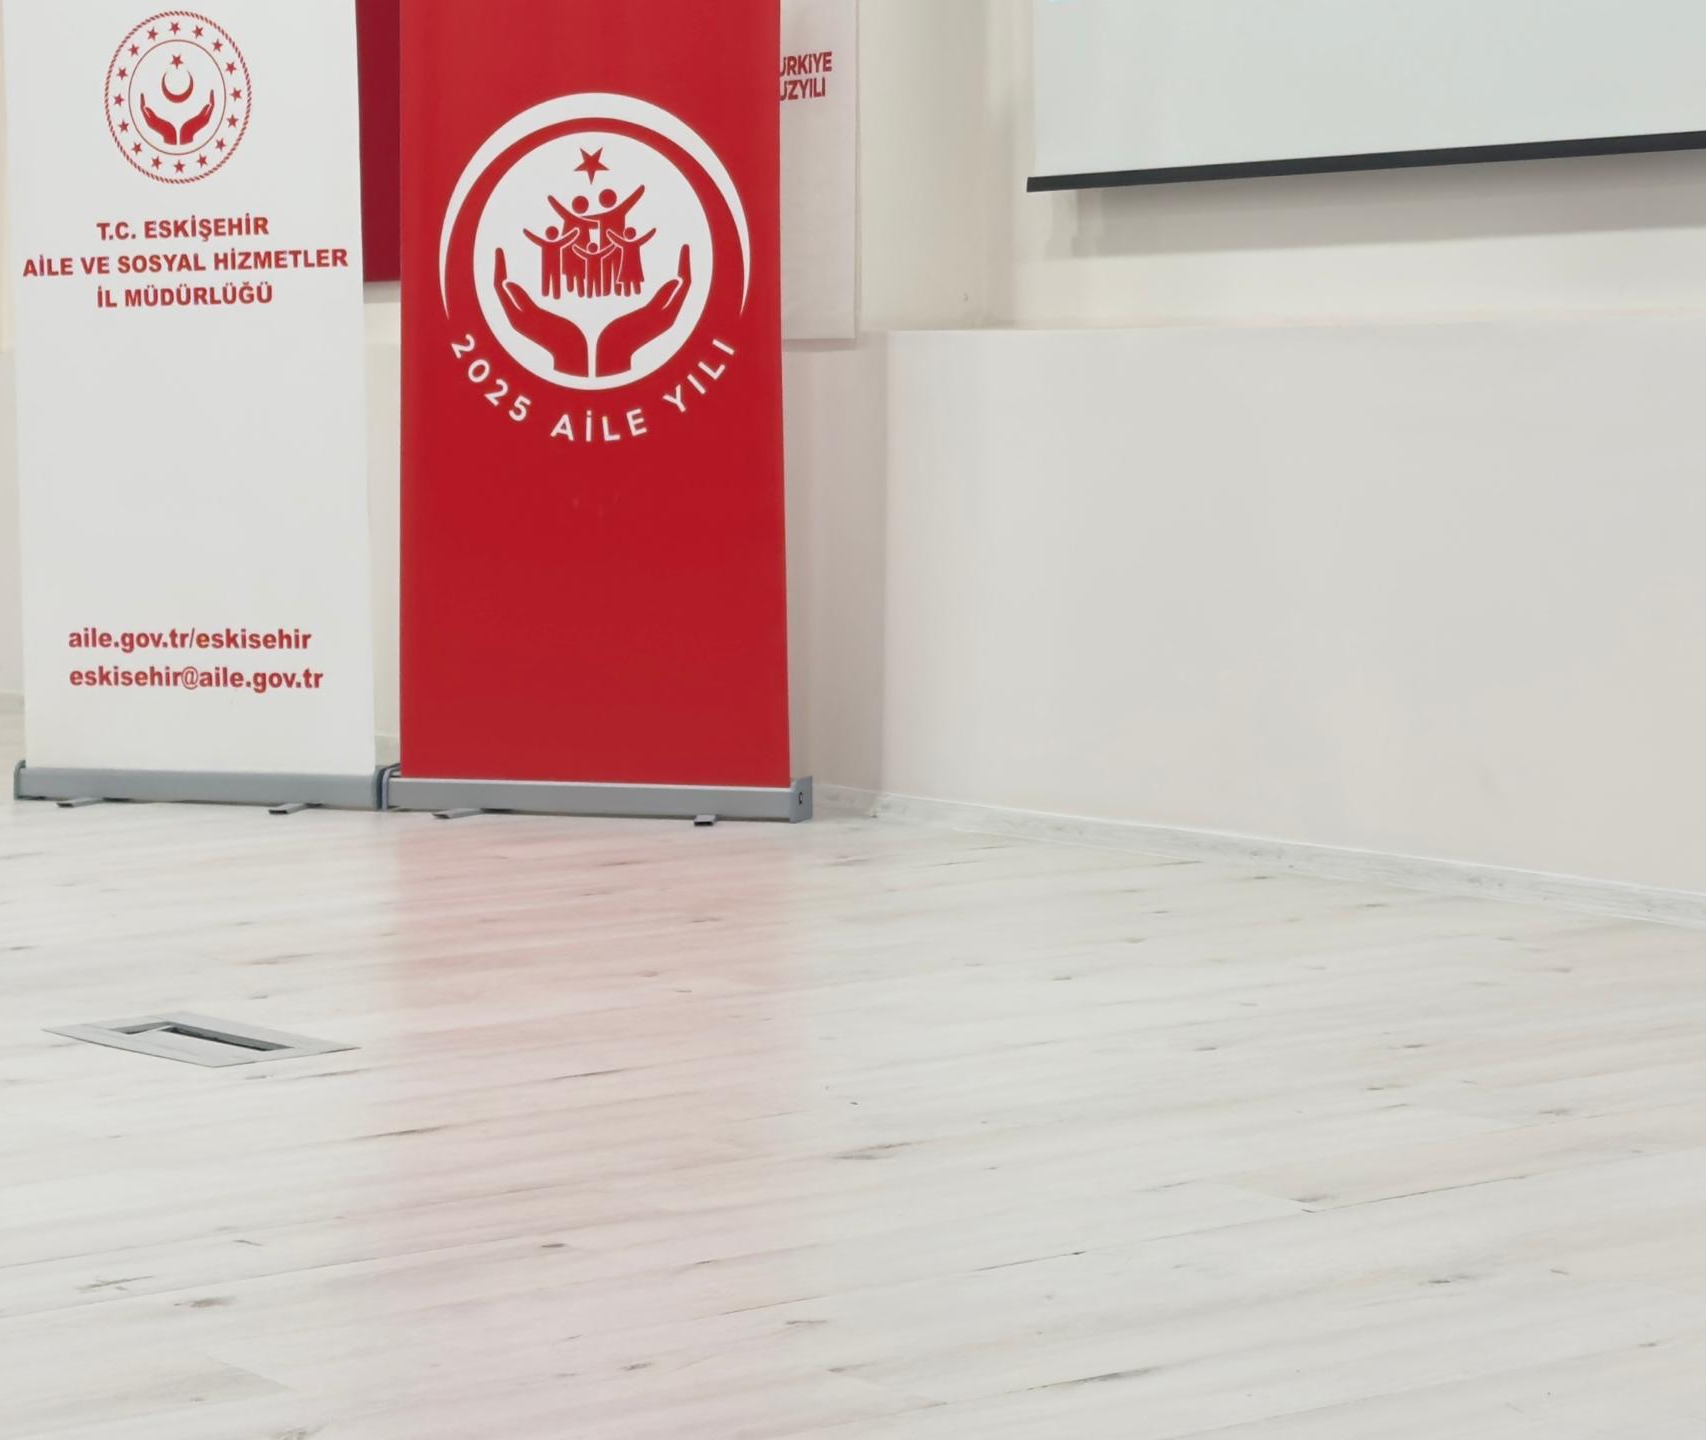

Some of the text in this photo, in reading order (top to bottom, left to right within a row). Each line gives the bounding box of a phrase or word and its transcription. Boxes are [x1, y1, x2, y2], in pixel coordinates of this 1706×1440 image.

[96, 213, 269, 242] T.C. ESKİŞEHİR
[22, 247, 349, 277] AİLE VE SOSYAL HİZMETLER
[97, 281, 274, 308] İL MÜDÜRLÜĞÜ
[451, 334, 736, 443] 2025 AİLE YILI
[68, 627, 312, 653] aile.gov.tr/eskisehir
[69, 666, 324, 693] eskisehir@aile.gov.tr
